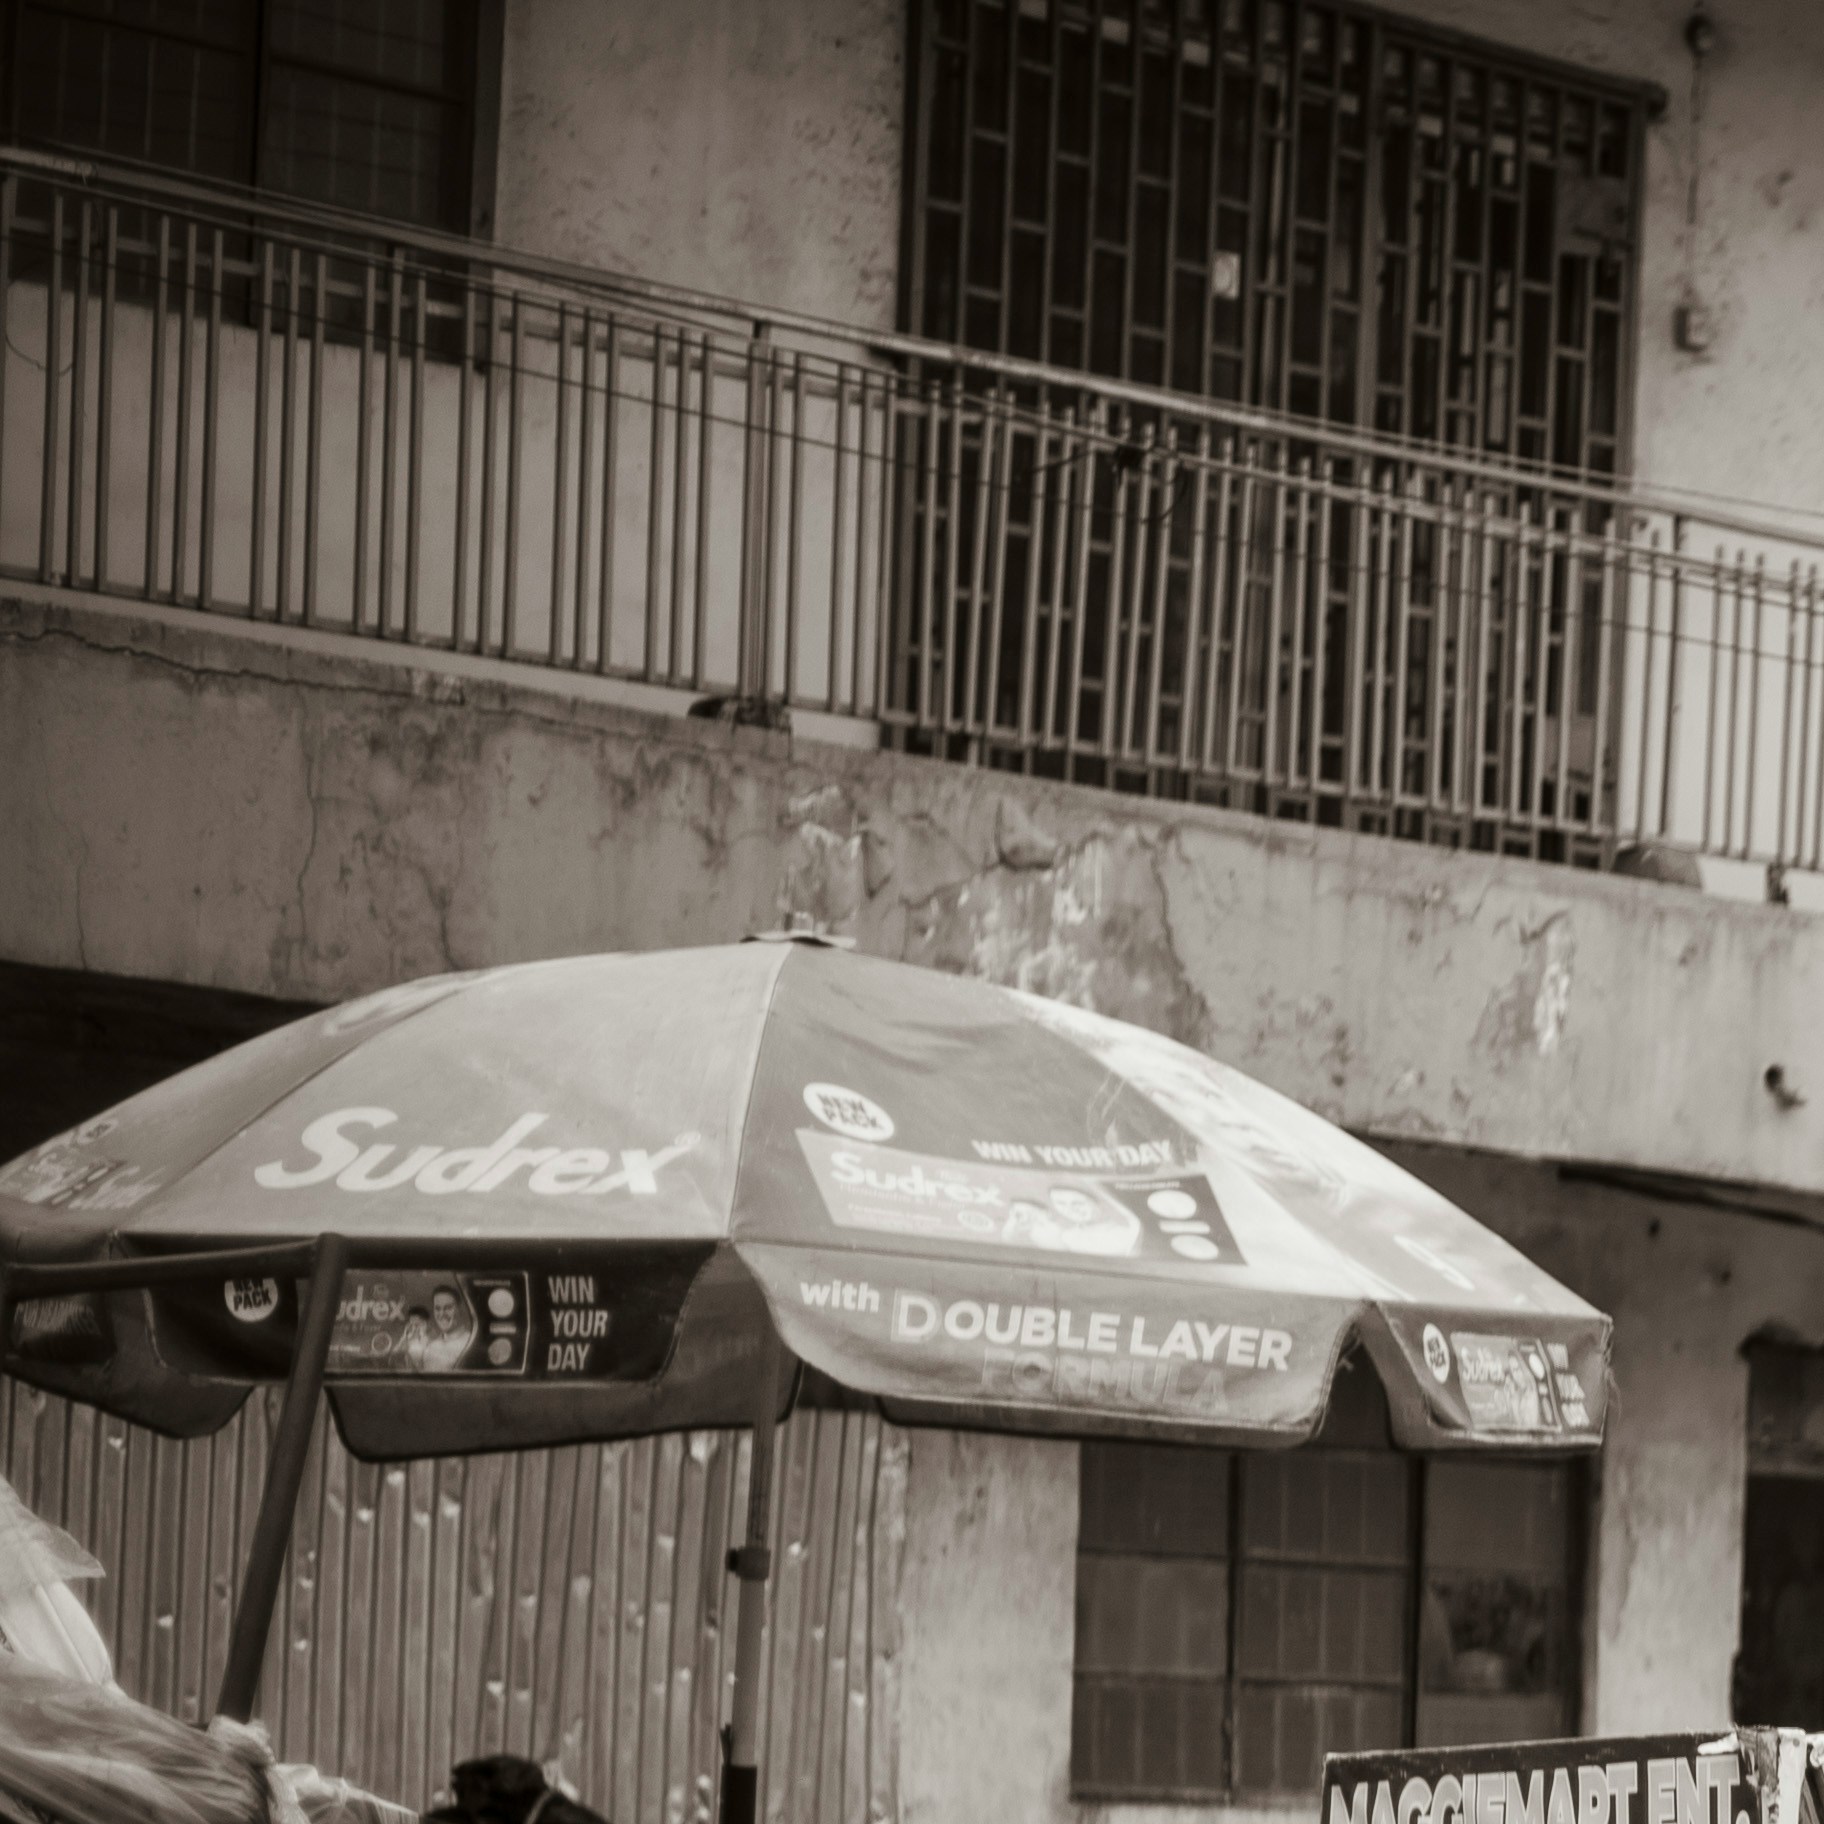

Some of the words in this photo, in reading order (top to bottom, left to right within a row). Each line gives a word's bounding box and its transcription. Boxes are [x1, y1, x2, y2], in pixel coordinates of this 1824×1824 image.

[254, 1106, 682, 1195] Sudrex
[973, 1140, 1032, 1165] WIN
[1039, 1144, 1113, 1168] YOUR
[1114, 1139, 1172, 1167] DAY
[831, 1150, 1004, 1210] Sudrex
[233, 1289, 272, 1310] PACK
[336, 1285, 403, 1322] udrex
[548, 1275, 595, 1304] WIN
[551, 1310, 608, 1337] YOUR
[800, 1280, 879, 1313] with
[1129, 1315, 1293, 1371] LAYER
[548, 1343, 591, 1372] DAY
